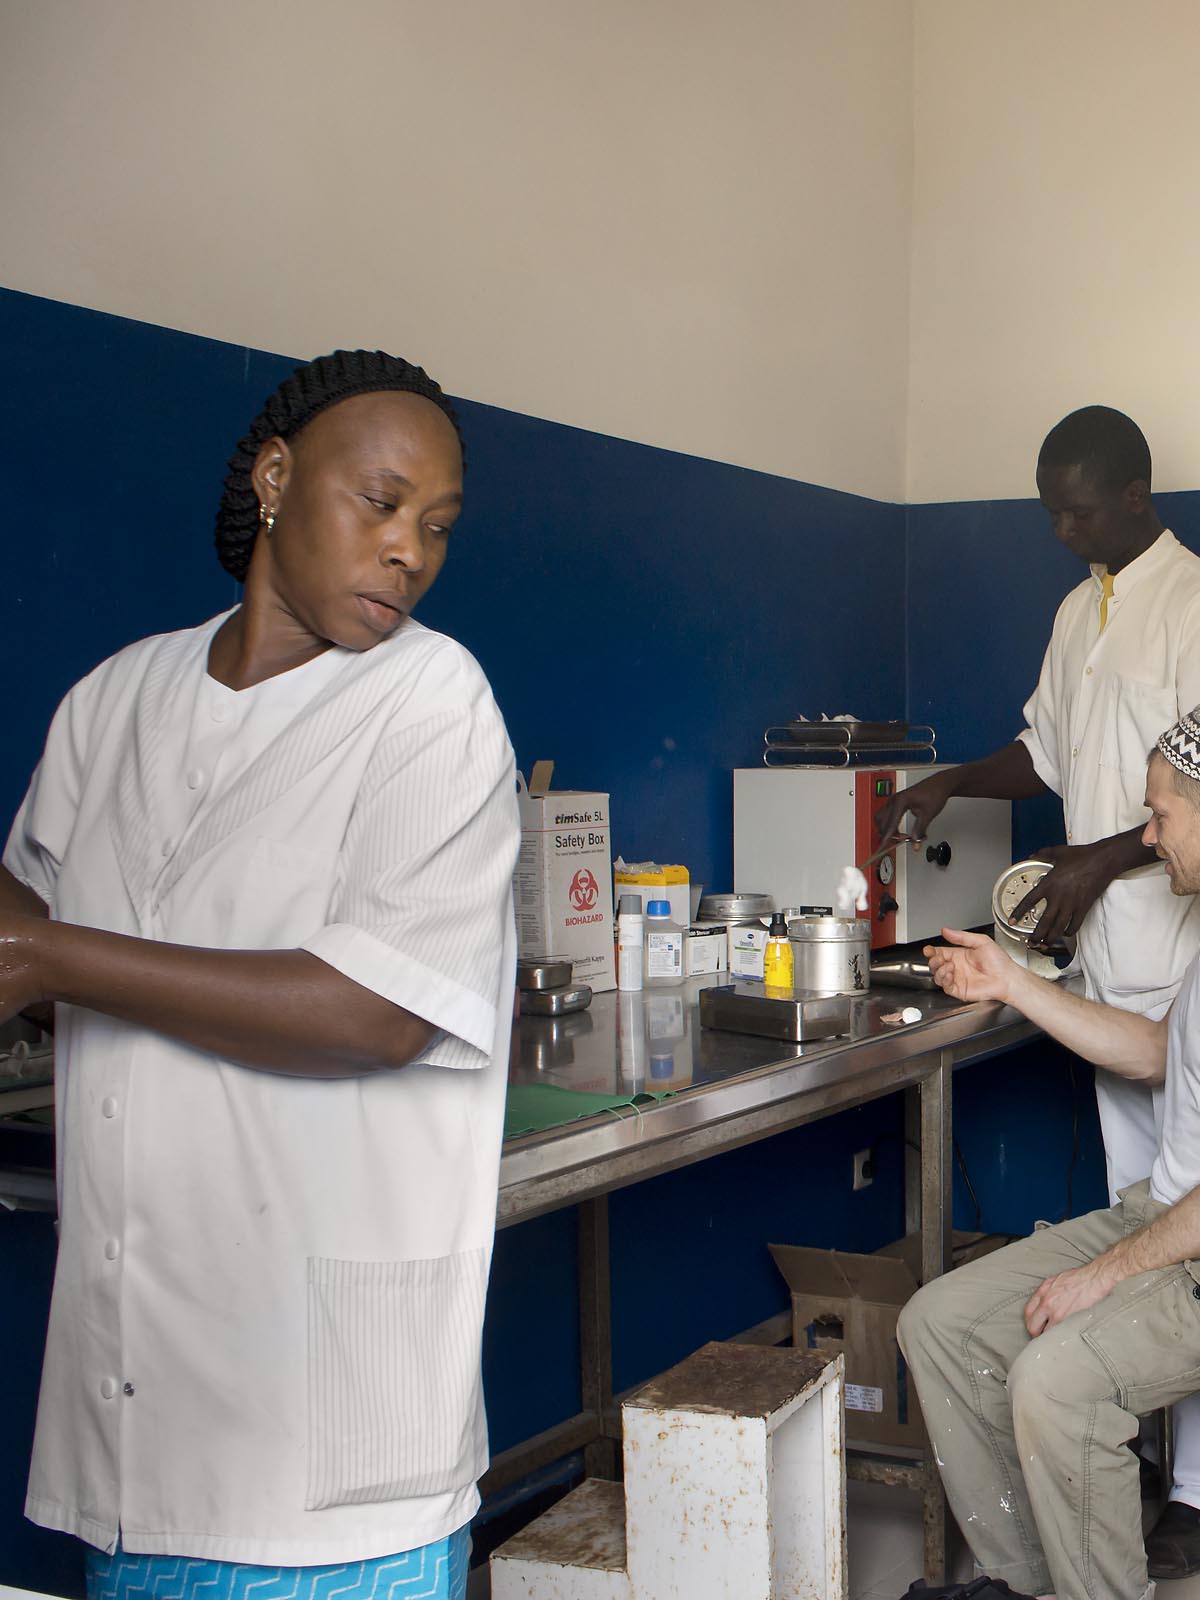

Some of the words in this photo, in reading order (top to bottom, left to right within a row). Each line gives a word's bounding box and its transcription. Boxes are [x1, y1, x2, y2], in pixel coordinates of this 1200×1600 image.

[594, 810, 604, 821] 5L
[555, 835, 585, 849] Safety
[588, 833, 605, 846] Box
[565, 913, 604, 926] BIOHAZARD
